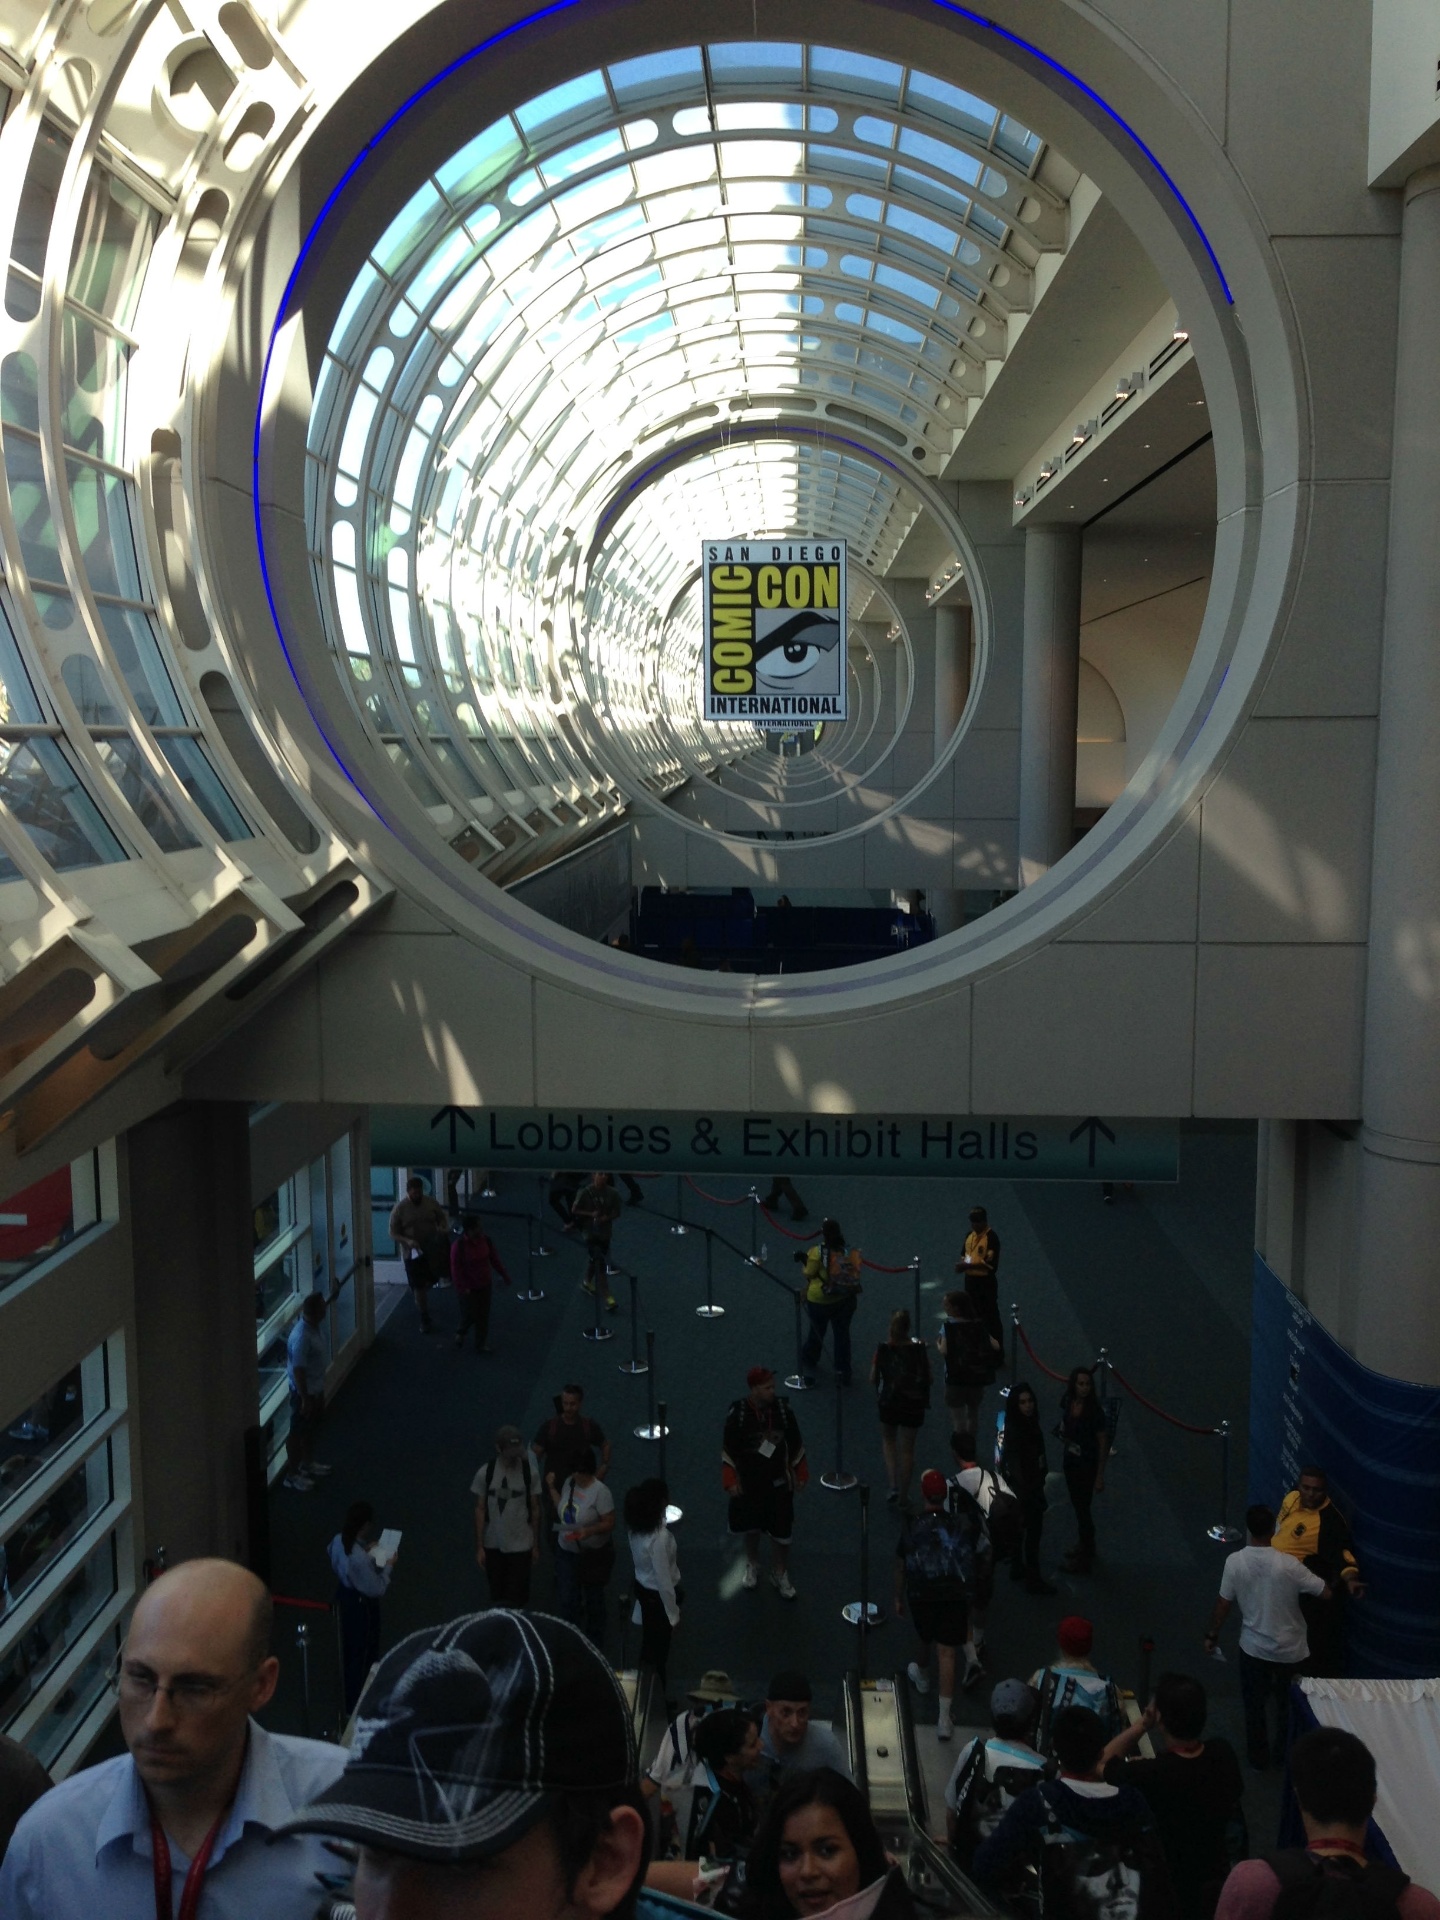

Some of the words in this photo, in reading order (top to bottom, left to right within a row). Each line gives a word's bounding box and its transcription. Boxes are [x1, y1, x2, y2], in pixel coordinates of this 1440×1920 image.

[709, 546, 750, 561] SAN
[772, 546, 841, 561] DIEGO
[757, 565, 839, 609] CON
[711, 565, 753, 694] COMIC
[710, 697, 842, 715] INTERNATIONAL
[489, 1111, 672, 1154] Lobbies
[690, 1117, 722, 1156] &
[742, 1118, 902, 1159] Exhibit
[920, 1120, 1039, 1161] Halls
